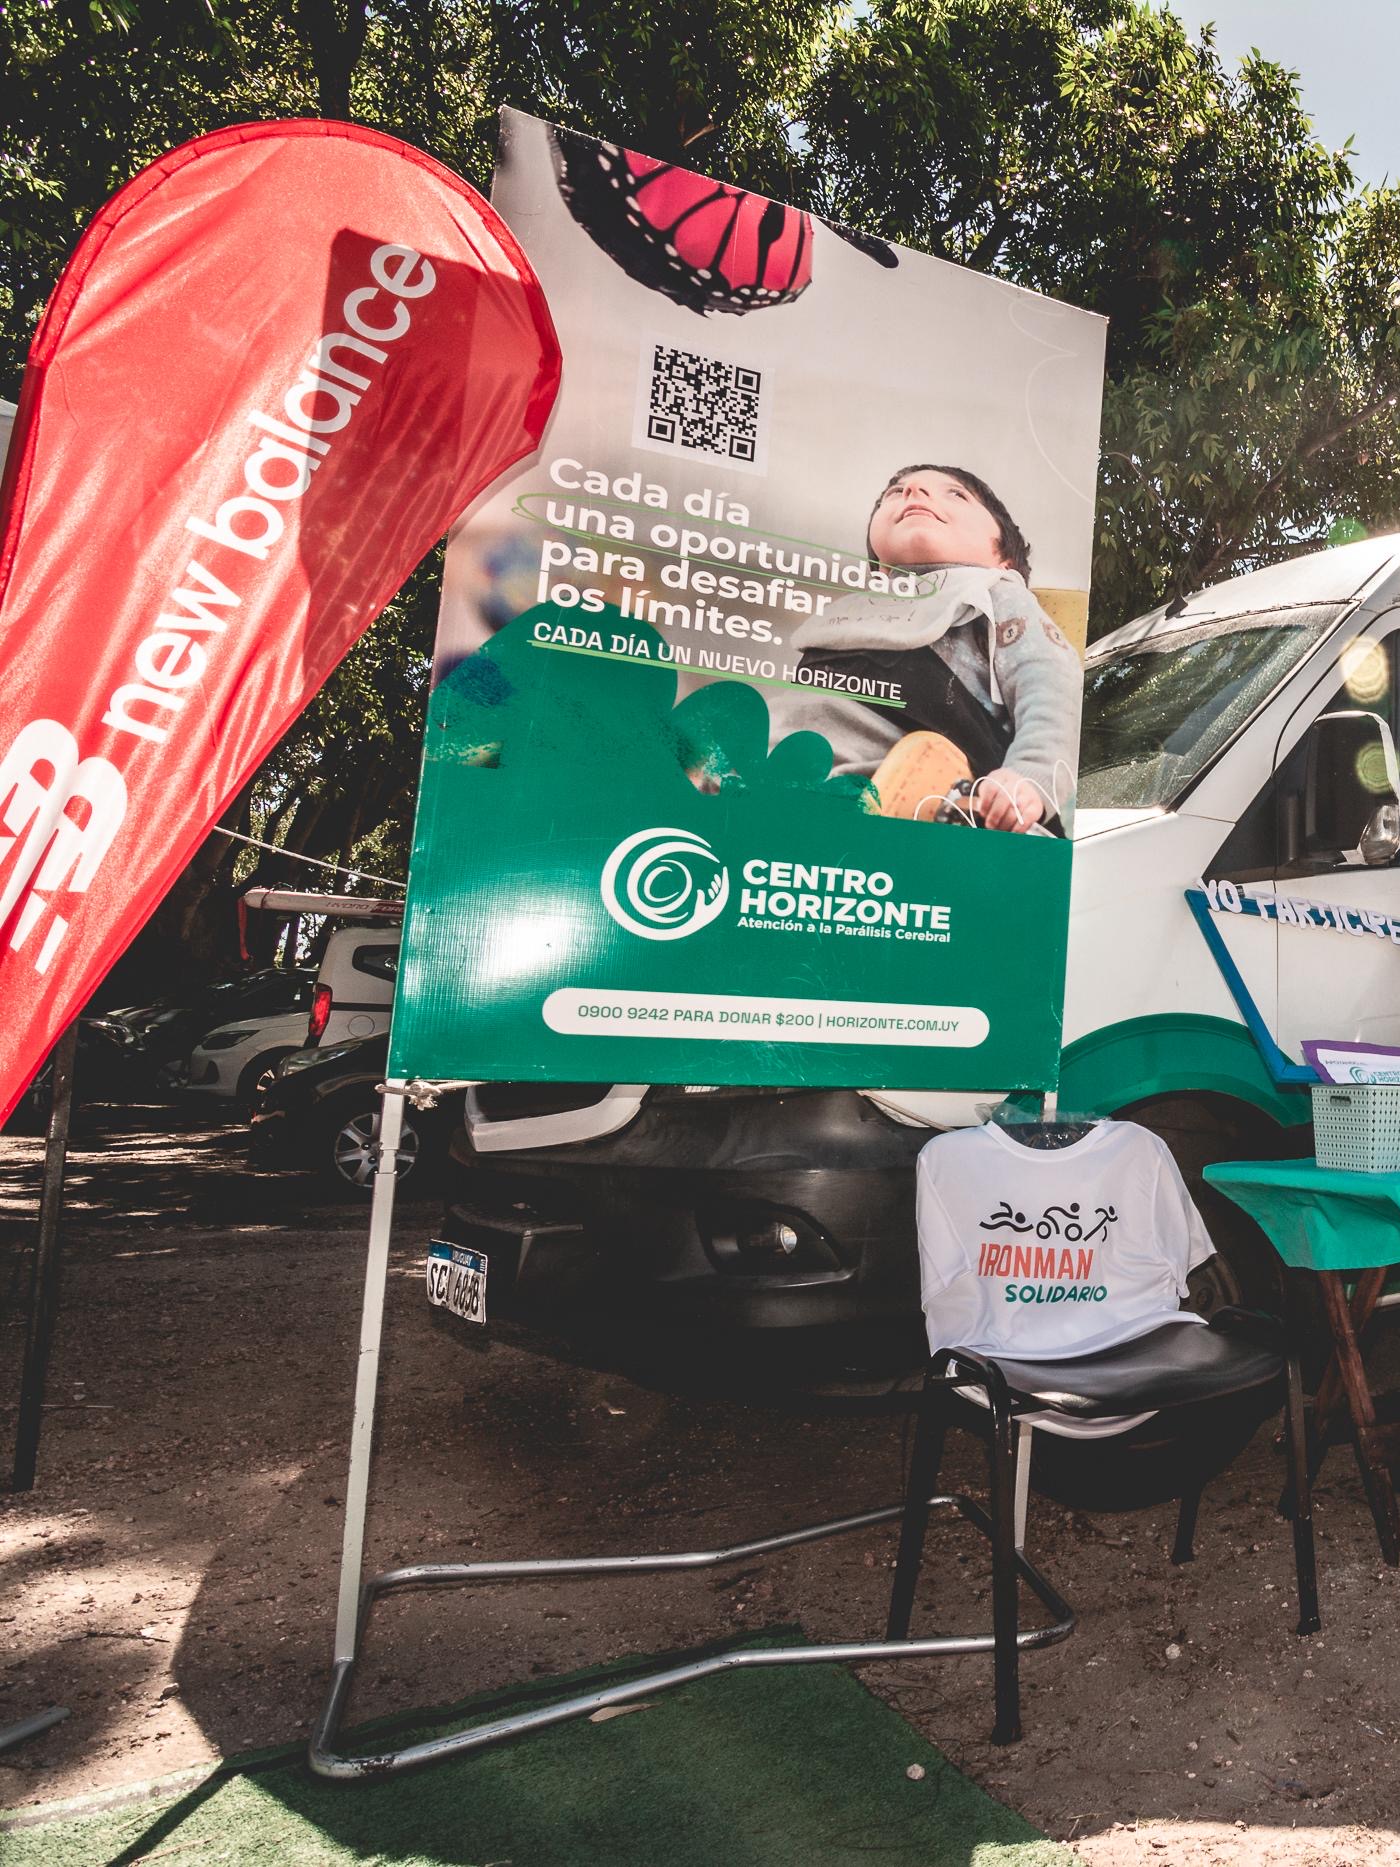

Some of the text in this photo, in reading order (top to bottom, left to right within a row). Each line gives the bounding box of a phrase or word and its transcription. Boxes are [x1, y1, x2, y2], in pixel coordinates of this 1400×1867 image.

[102, 243, 437, 744] new balance
[549, 457, 750, 527] Cada día
[545, 500, 917, 598] una oportunidad
[540, 539, 832, 617] para desafiar
[536, 570, 783, 646] los límites.
[533, 621, 902, 700] CADA DÍA UN NUEVO HORIZONTE
[742, 859, 894, 897] CENTRO
[1197, 877, 1243, 914] YO
[737, 916, 951, 943] Atención a la Parálisis Cerebral
[739, 888, 951, 930] HORIZONTE
[577, 1004, 623, 1019] 0900
[627, 1006, 669, 1021] 9242
[673, 1009, 715, 1023] PARA
[718, 1011, 771, 1025] DONAR
[775, 1012, 815, 1027] $200
[826, 1015, 960, 1032] HORIZONTE.COM.UY
[977, 1243, 1094, 1280] IRONMAN
[1005, 1284, 1108, 1304] SOLIDARIO
